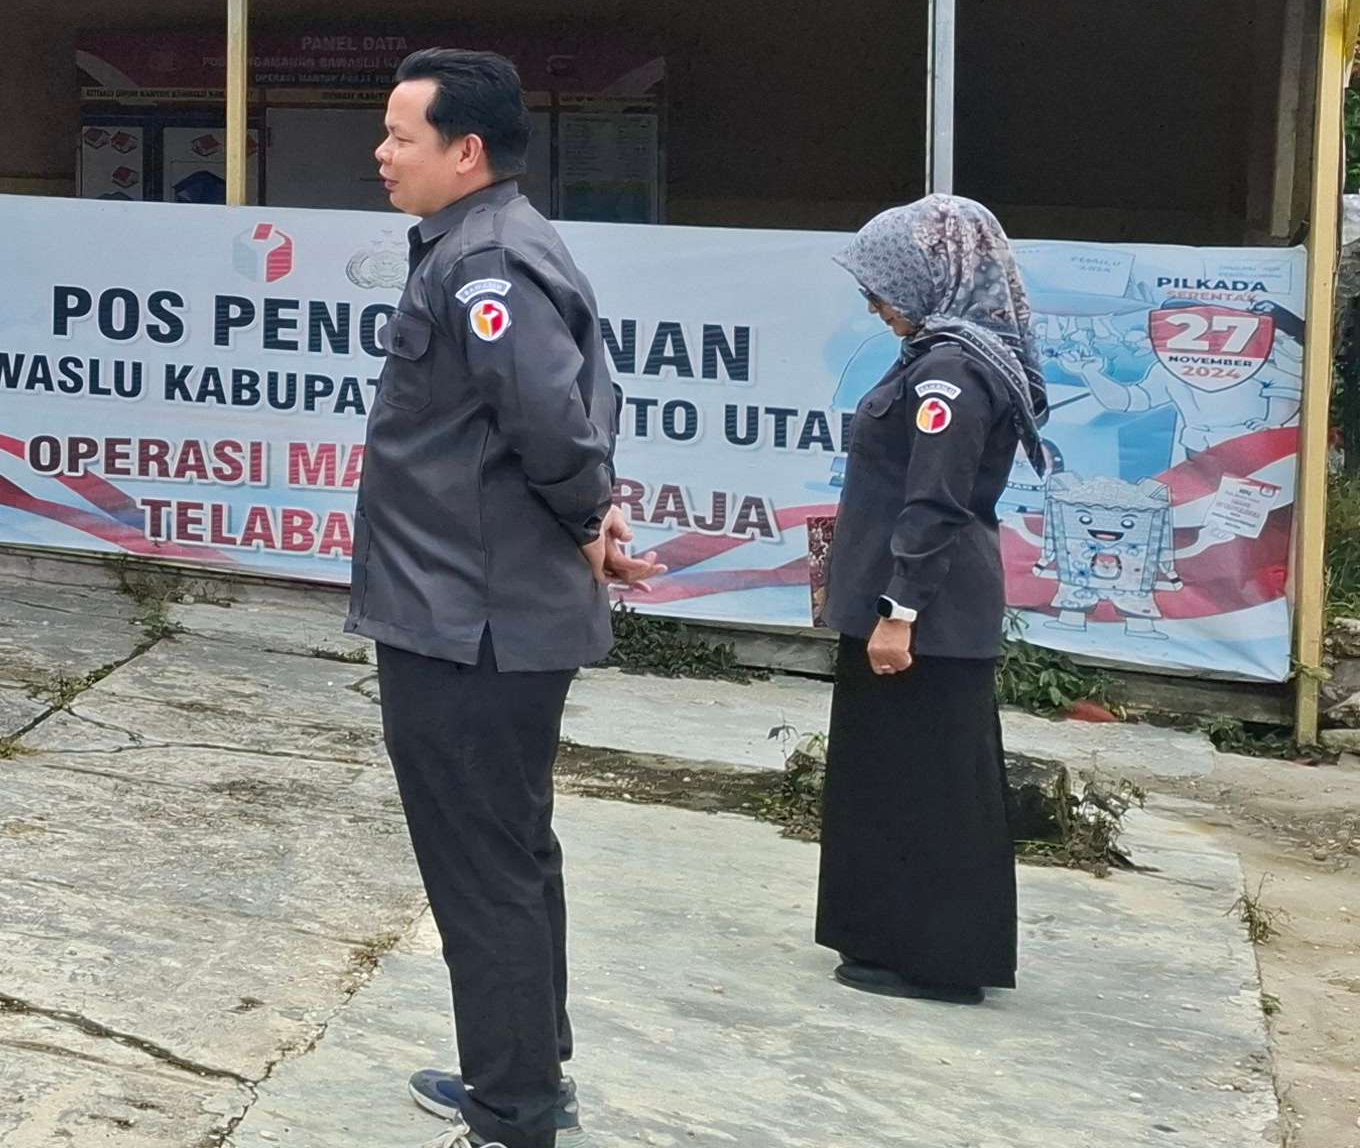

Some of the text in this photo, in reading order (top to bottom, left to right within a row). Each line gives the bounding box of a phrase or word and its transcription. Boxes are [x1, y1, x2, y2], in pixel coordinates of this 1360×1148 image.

[301, 36, 408, 51] PANEL DATA
[1156, 277, 1268, 293] PILKADA
[1166, 290, 1257, 302] SERENTAK
[52, 284, 185, 344] POS
[1165, 312, 1260, 353] 27
[1168, 355, 1253, 367] NOVEMBER
[1181, 365, 1242, 379] 2024
[28, 435, 263, 484] OPERASI
